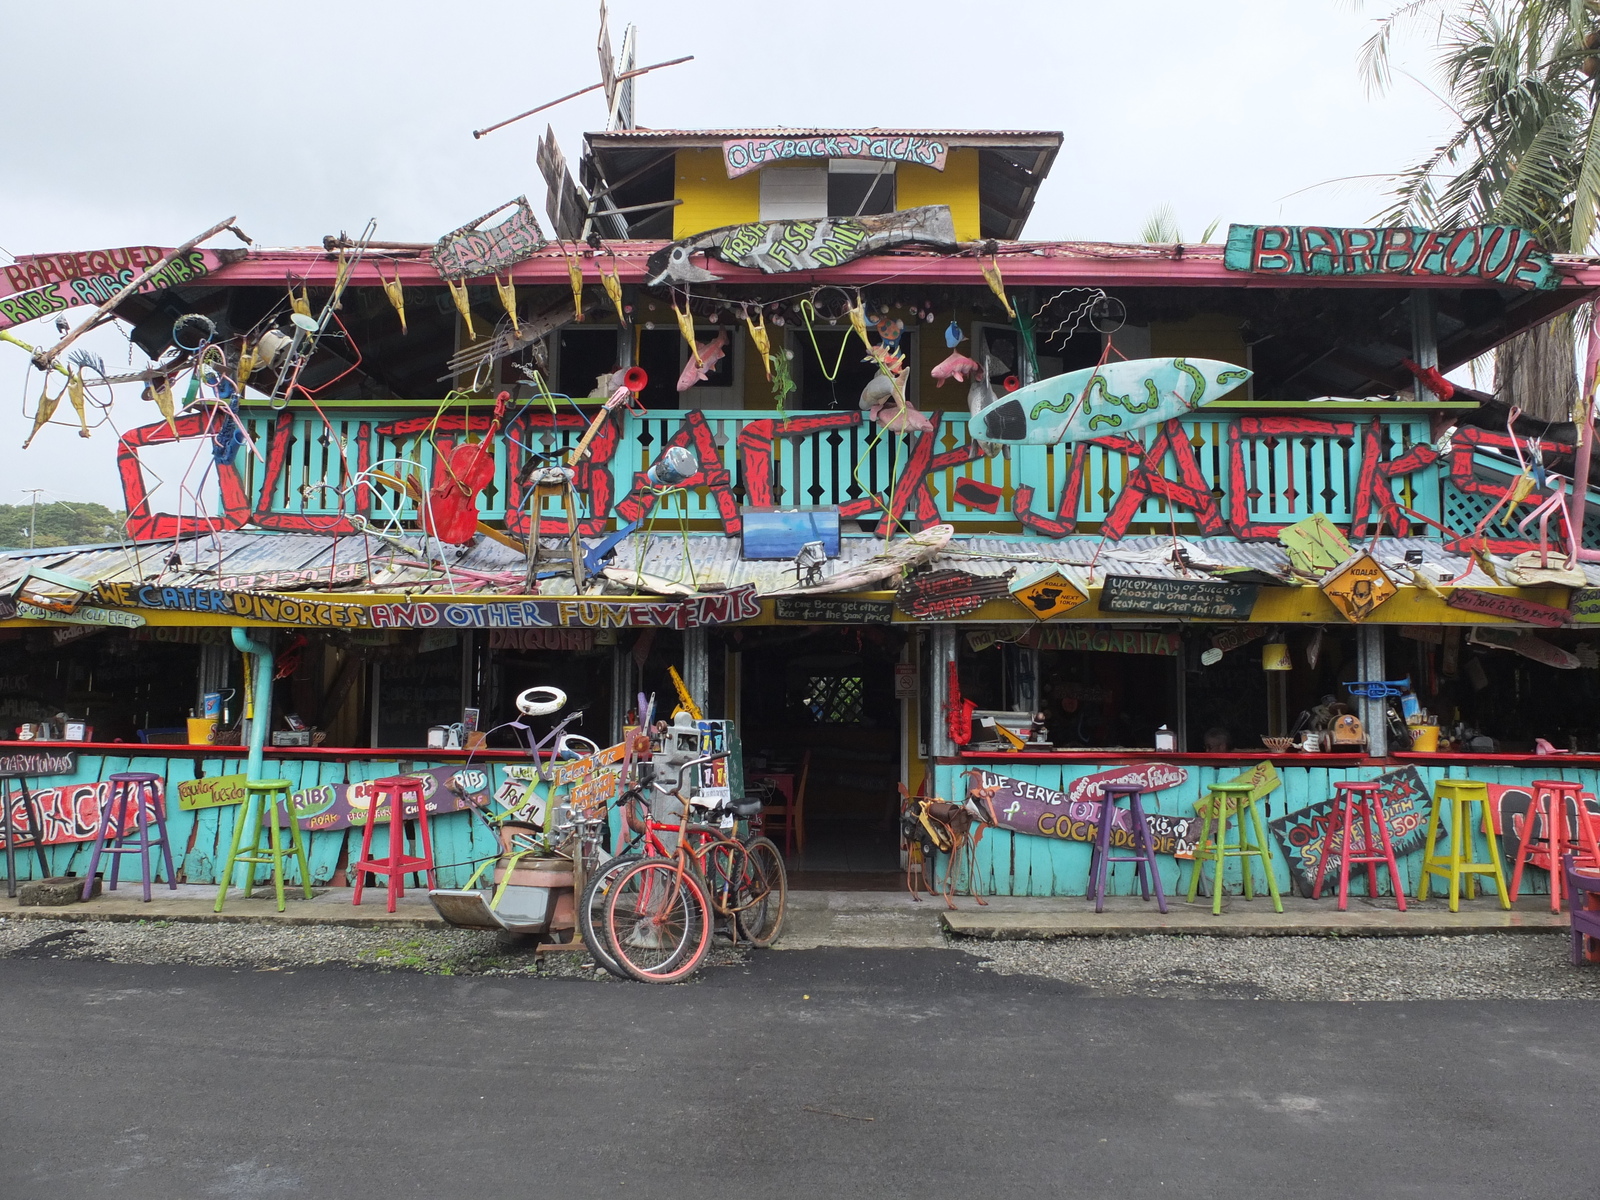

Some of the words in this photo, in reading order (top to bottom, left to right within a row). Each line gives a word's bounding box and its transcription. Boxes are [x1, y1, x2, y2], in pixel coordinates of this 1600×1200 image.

[719, 222, 769, 263] FRESH
[768, 221, 818, 268] FISH
[3, 246, 164, 293] BARBEQUED
[1, 284, 66, 325] RIBS
[1350, 568, 1378, 576] KOALAS
[98, 582, 138, 607] WE
[138, 585, 229, 613] CATER
[233, 592, 365, 628] DIVORCES
[369, 602, 440, 628] AND
[445, 600, 551, 627] OTHER
[841, 601, 857, 613] get
[911, 594, 981, 618] Snapper
[107, 609, 140, 627] BEER
[863, 613, 891, 623] price
[489, 627, 593, 650] DAIQUIRI
[292, 784, 330, 811] RIBS
[981, 771, 1012, 789] WE
[1012, 779, 1063, 806] SERVE
